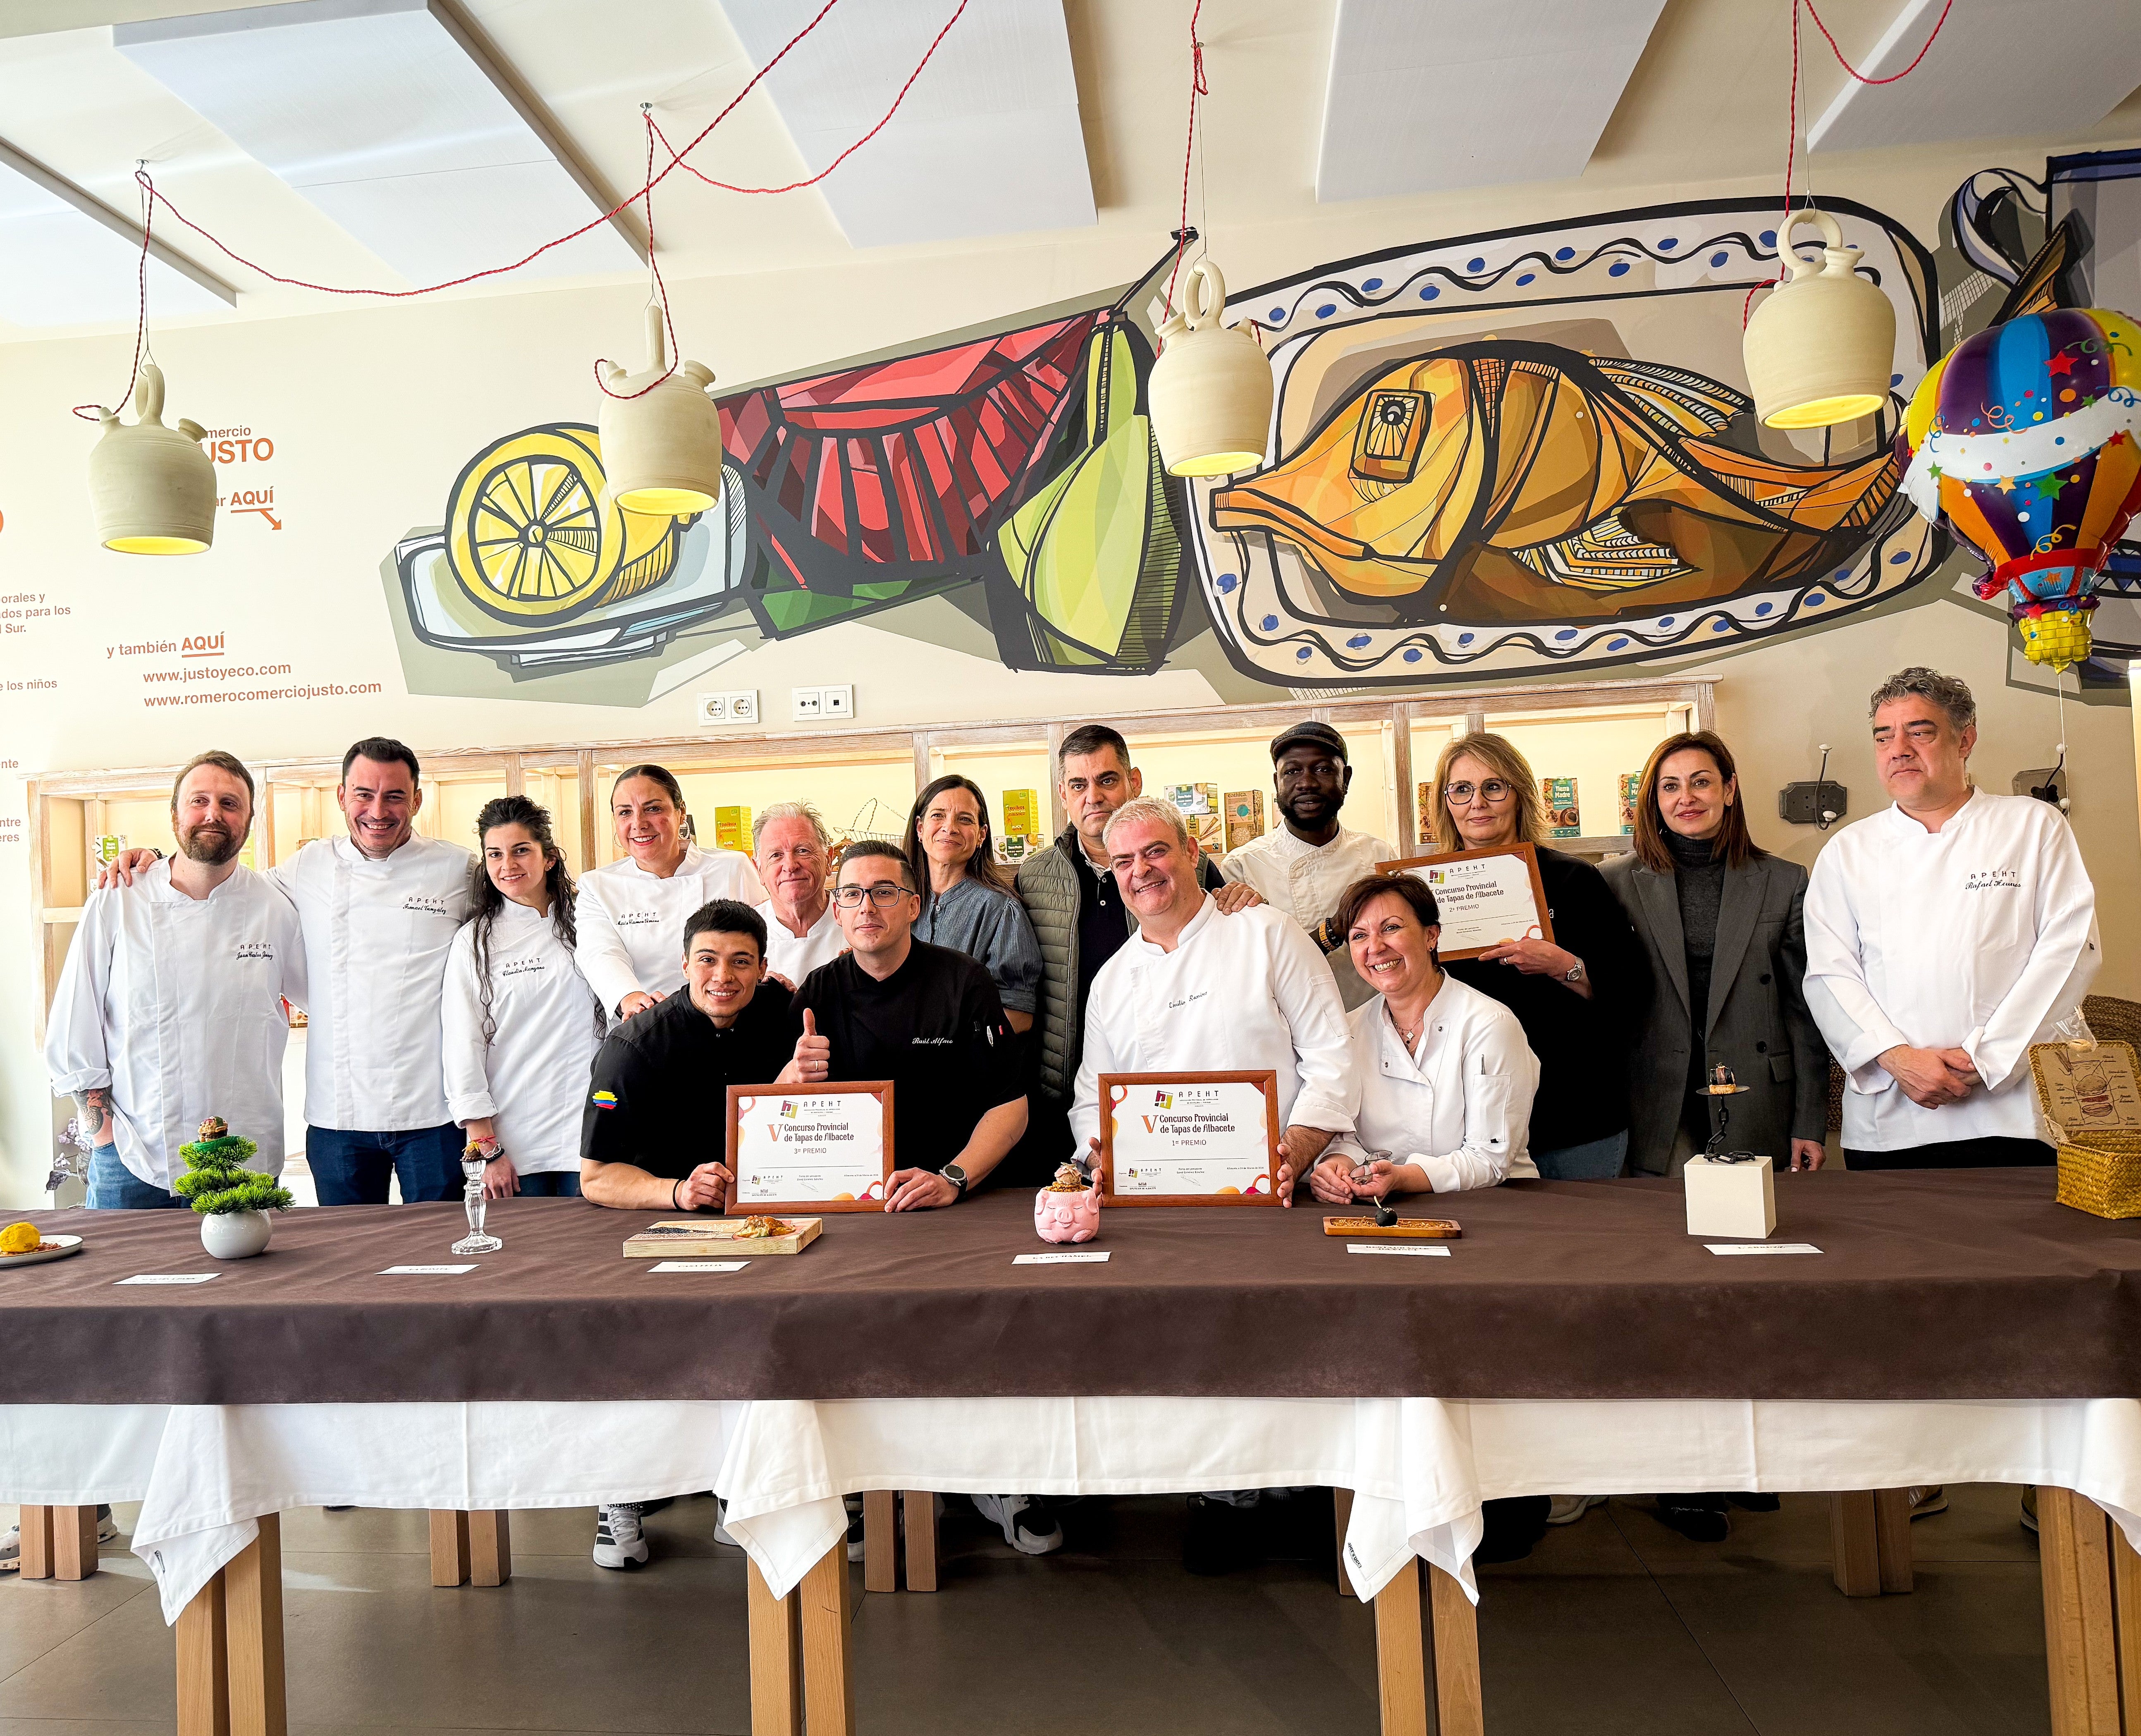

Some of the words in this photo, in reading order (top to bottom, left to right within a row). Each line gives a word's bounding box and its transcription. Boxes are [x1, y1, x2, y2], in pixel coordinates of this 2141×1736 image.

[207, 425, 251, 438] mercio
[230, 485, 274, 505] AQUÍ
[0, 593, 36, 603] orales
[39, 594, 45, 603] y
[0, 609, 22, 618] dos
[26, 608, 50, 619] para
[55, 605, 71, 615] los
[5, 624, 26, 633] Sur.
[107, 647, 114, 659] y
[119, 640, 177, 655] también
[182, 631, 225, 651] AQUÍ
[143, 664, 291, 683] www.justoyeco.com
[7, 681, 23, 691] los
[27, 679, 57, 689] niños
[144, 683, 382, 707] www.romerocomerciojusto.com
[0, 759, 19, 768] nte
[0, 818, 21, 827] ntre
[1435, 887, 1465, 895] Concurso
[1466, 880, 1497, 891] Provincial
[1475, 890, 1504, 899] Albacete
[1141, 1115, 1159, 1133] V
[1194, 1113, 1228, 1122] Provincial
[767, 1124, 783, 1141] V
[817, 1122, 848, 1131] Provincial
[1160, 1125, 1169, 1133] de
[1171, 1125, 1190, 1136] Tapas
[1203, 1124, 1235, 1133] Albacete
[794, 1133, 812, 1144] Tapas
[824, 1132, 854, 1141] Albacete
